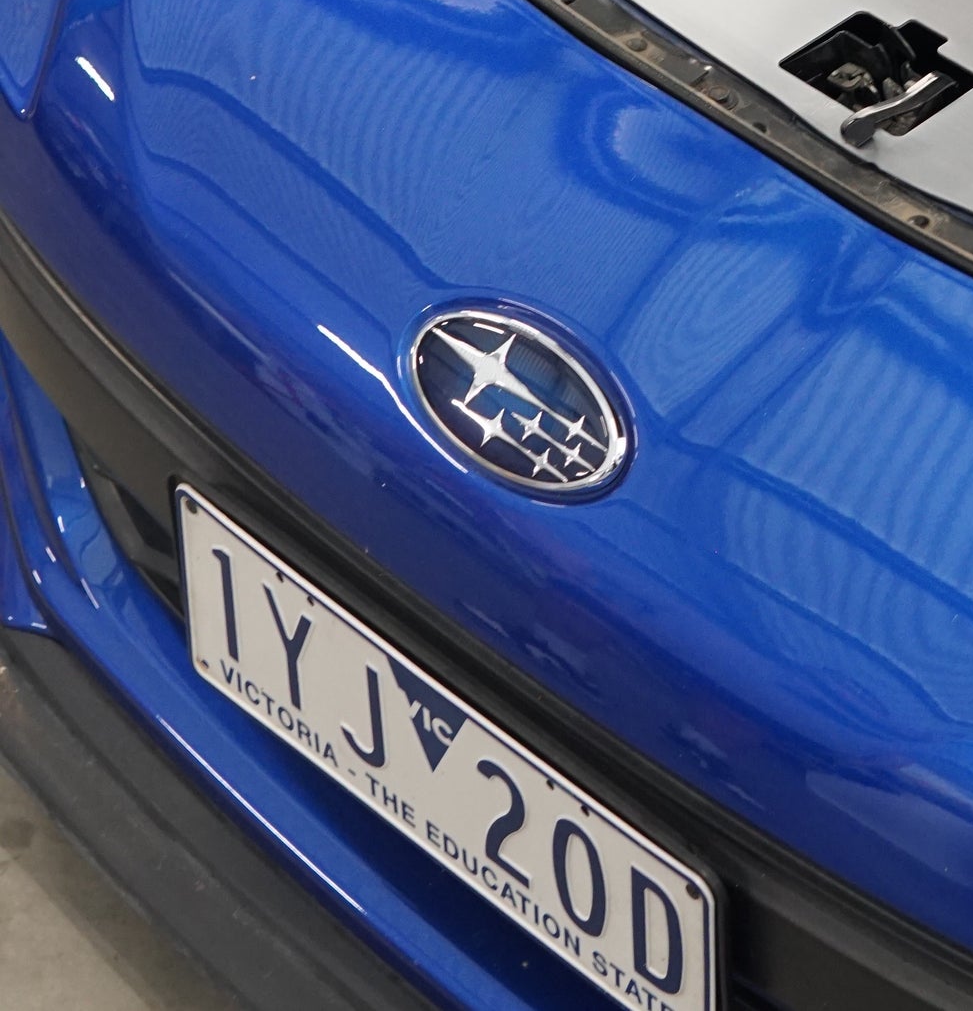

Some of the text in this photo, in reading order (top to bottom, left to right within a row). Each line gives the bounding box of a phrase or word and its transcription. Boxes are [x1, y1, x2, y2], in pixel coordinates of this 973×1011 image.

[219, 659, 338, 768] VICTORIA
[365, 772, 416, 828] THE
[426, 820, 580, 957] EDUCATION
[408, 699, 453, 747] VIC
